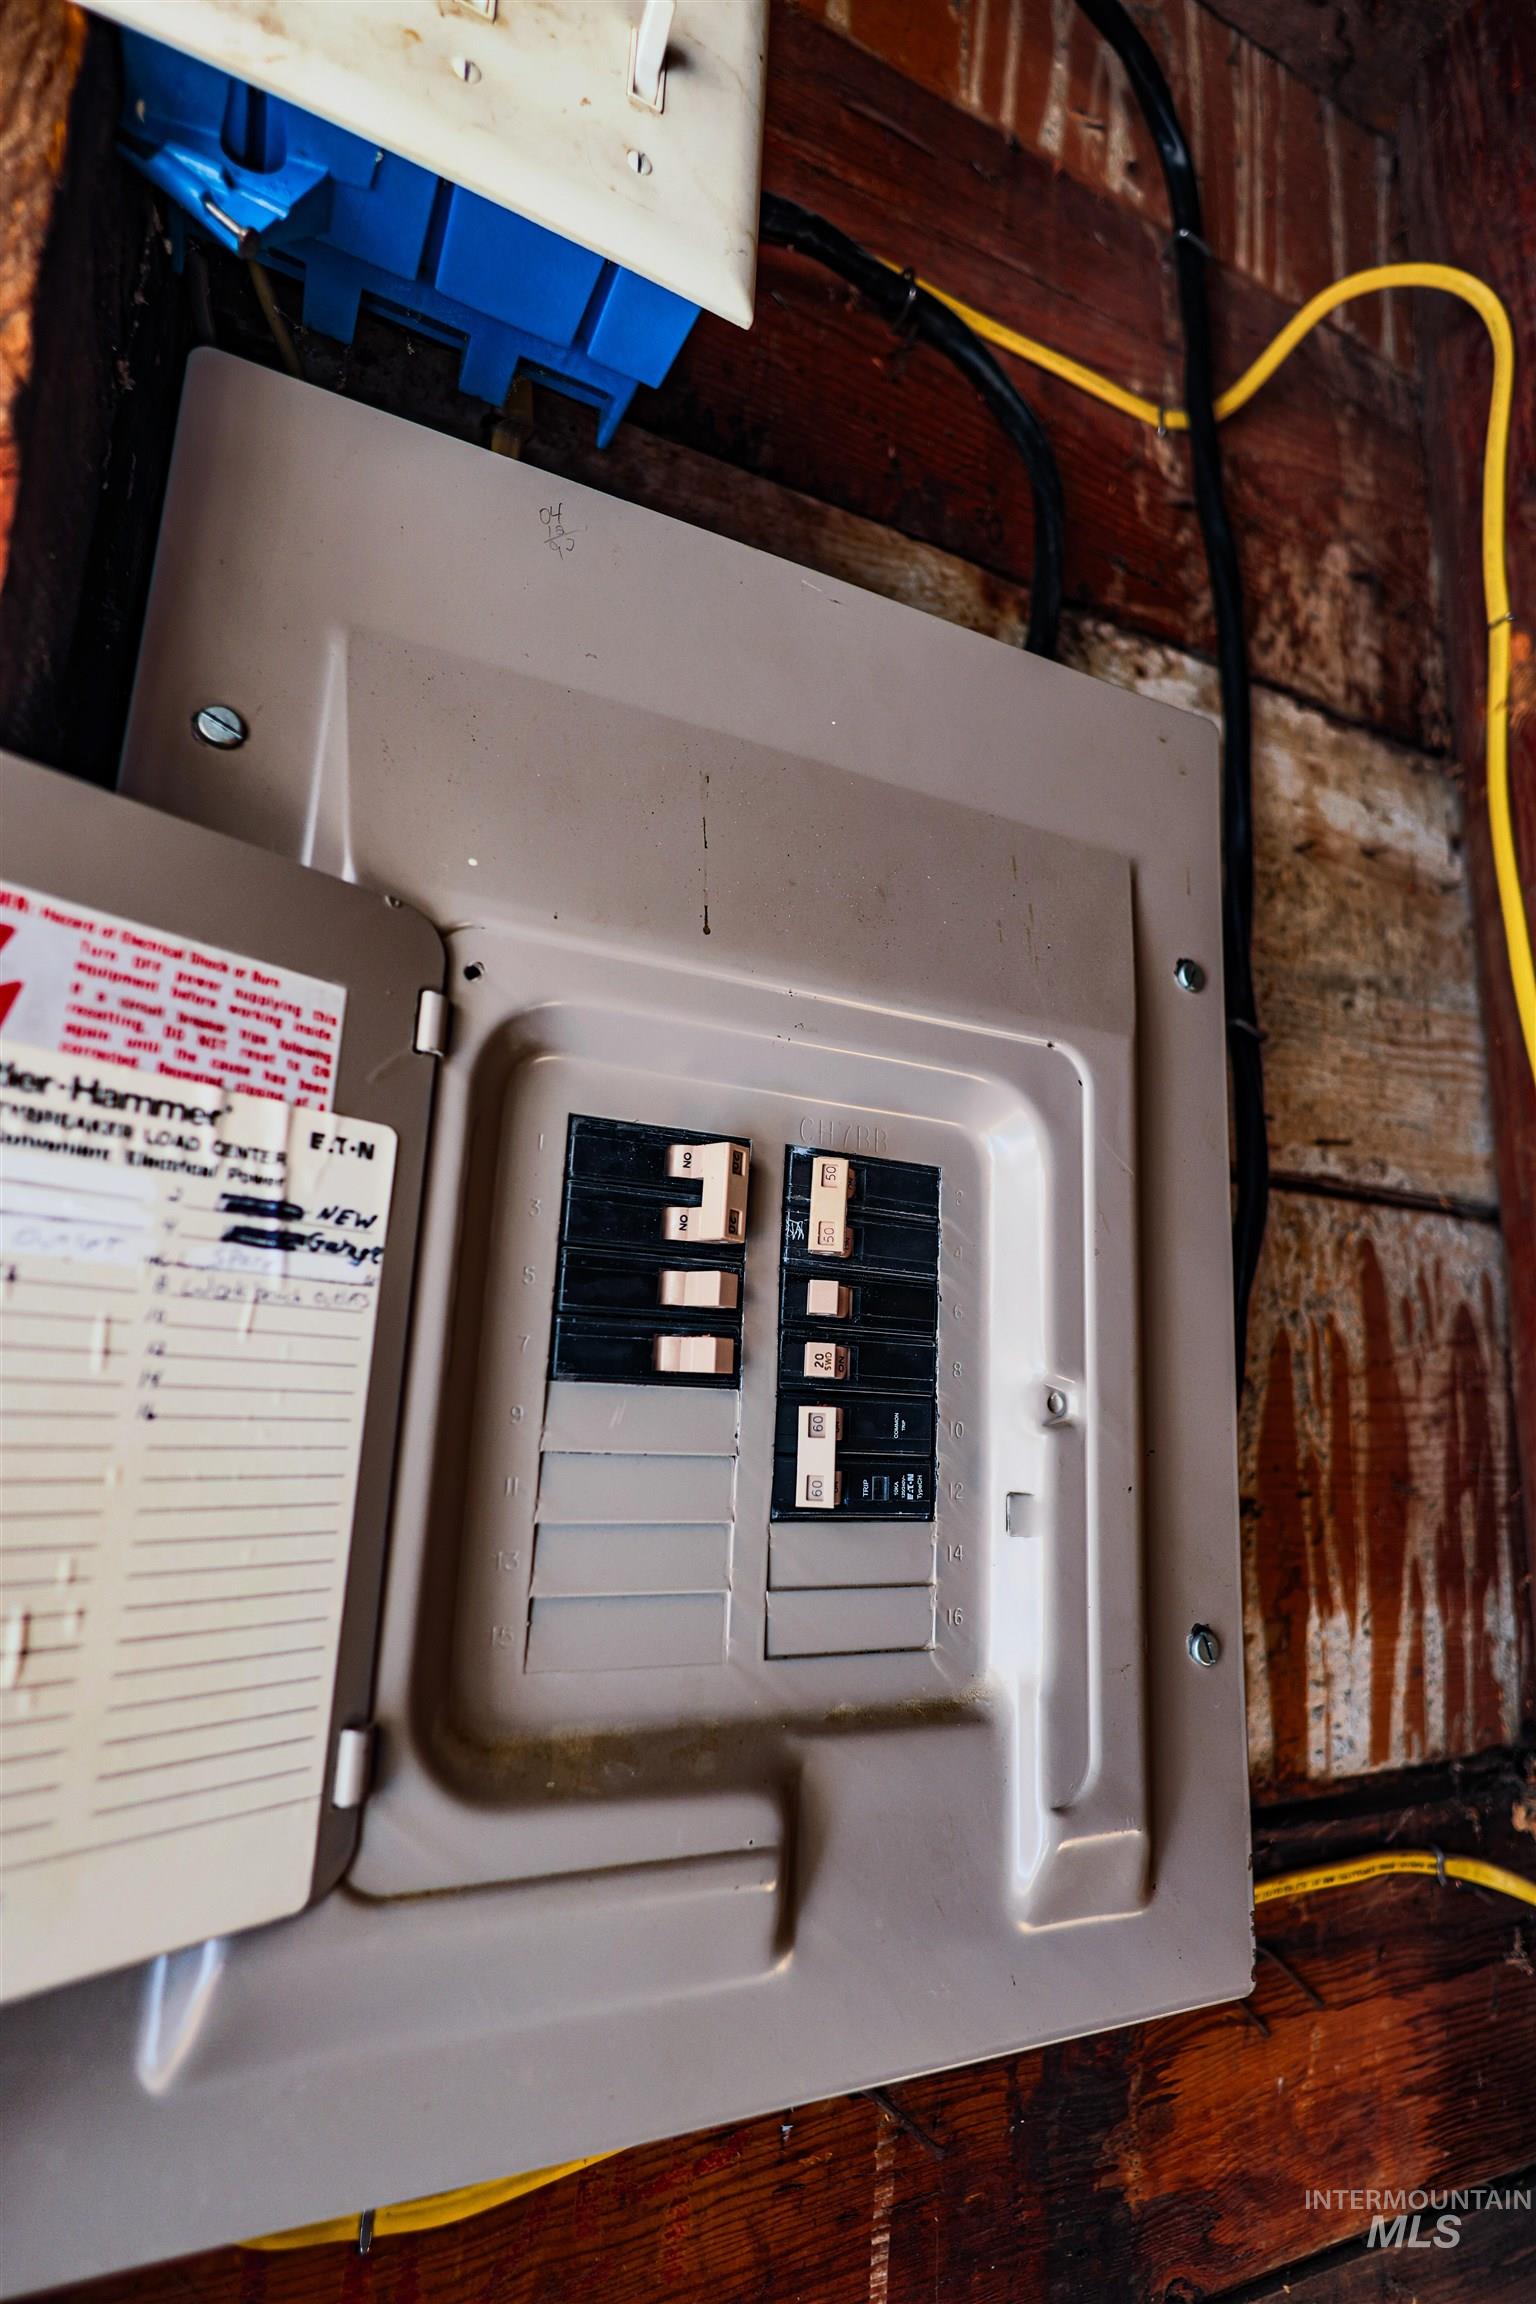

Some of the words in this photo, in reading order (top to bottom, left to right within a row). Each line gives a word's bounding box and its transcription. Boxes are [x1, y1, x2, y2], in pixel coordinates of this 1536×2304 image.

[683, 1151, 692, 1169] ON
[825, 1165, 837, 1181] 50
[317, 1206, 378, 1229] NEW
[679, 1214, 688, 1231] ON
[823, 1226, 835, 1243] 50
[814, 1353, 825, 1368] 20
[812, 1415, 824, 1432] 60
[811, 1480, 823, 1497] 60
